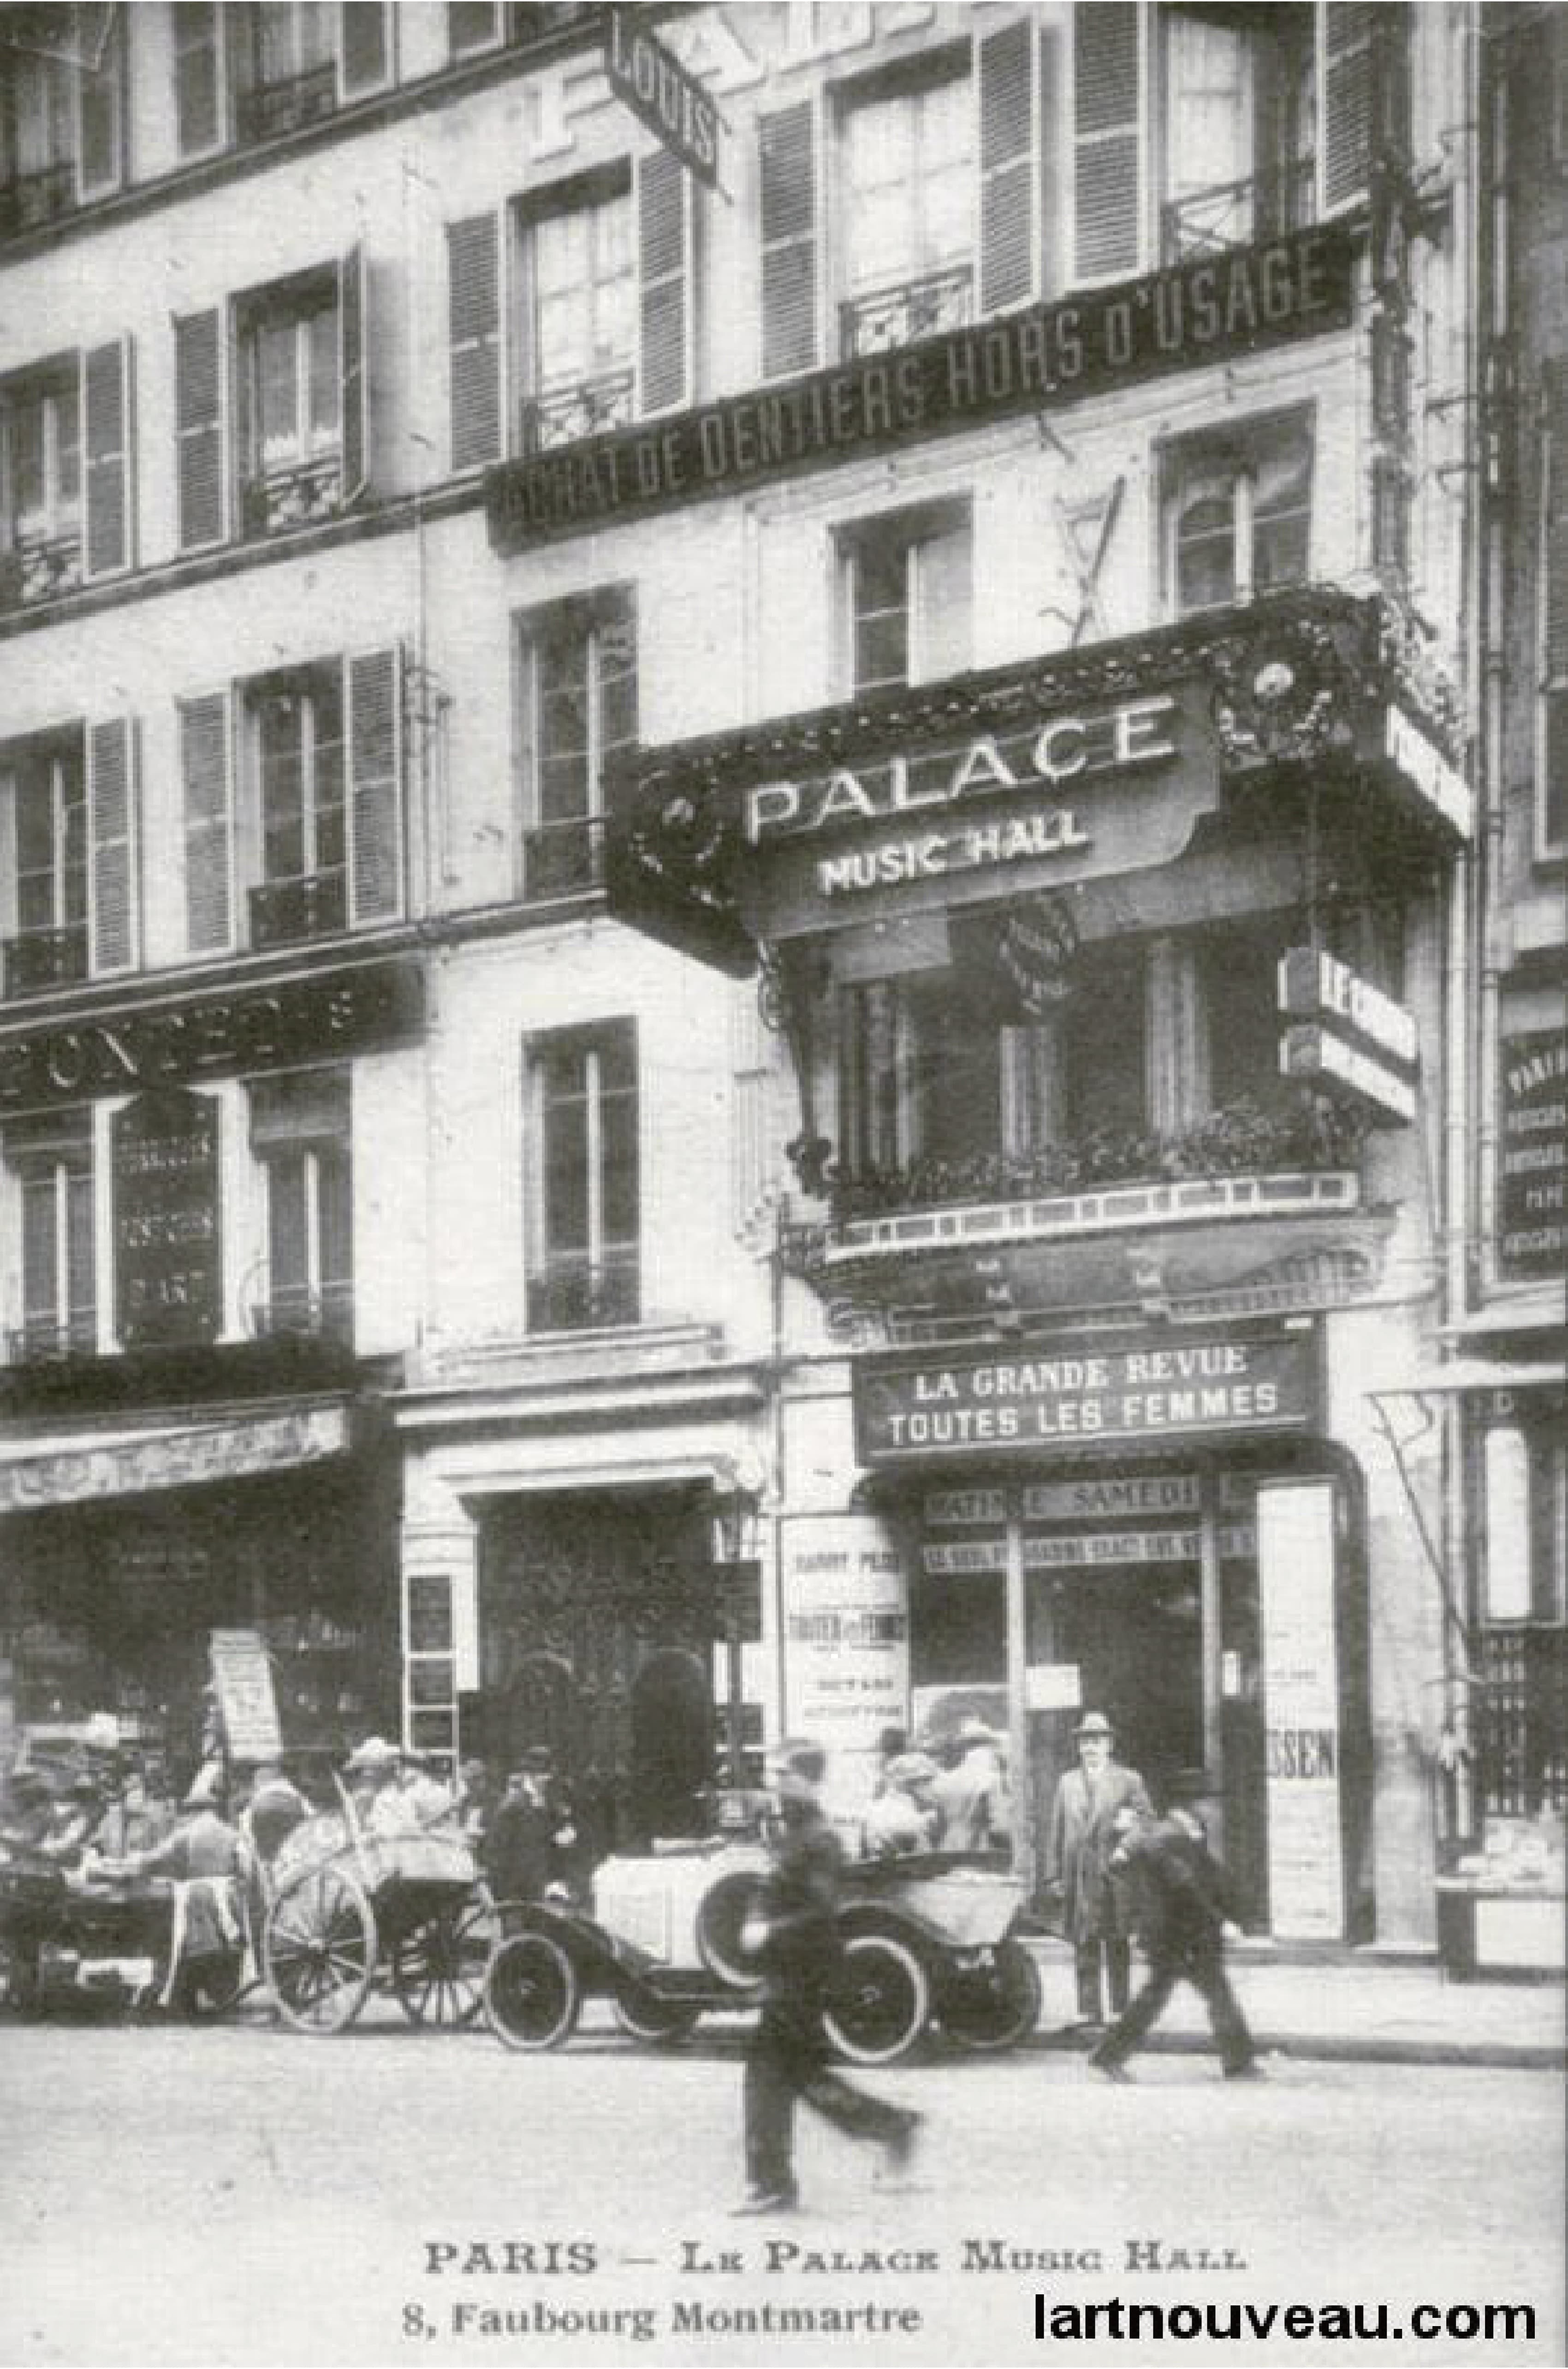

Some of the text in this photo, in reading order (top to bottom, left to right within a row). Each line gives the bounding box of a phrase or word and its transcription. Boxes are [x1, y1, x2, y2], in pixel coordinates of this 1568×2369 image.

[612, 7, 713, 165] LOUIS
[637, 429, 688, 491] DE
[700, 365, 922, 478] DENTIERS
[946, 311, 1085, 409] HORS
[1103, 238, 1329, 367] D'USAGE
[746, 696, 1175, 845] PALACE
[817, 810, 1087, 896] MUSIC HALL
[888, 1383, 1278, 1446] TOUTES LES FEMMES
[915, 1345, 1248, 1400] LA GRANDE REVUE
[1075, 1478, 1194, 1509] SAMEDI
